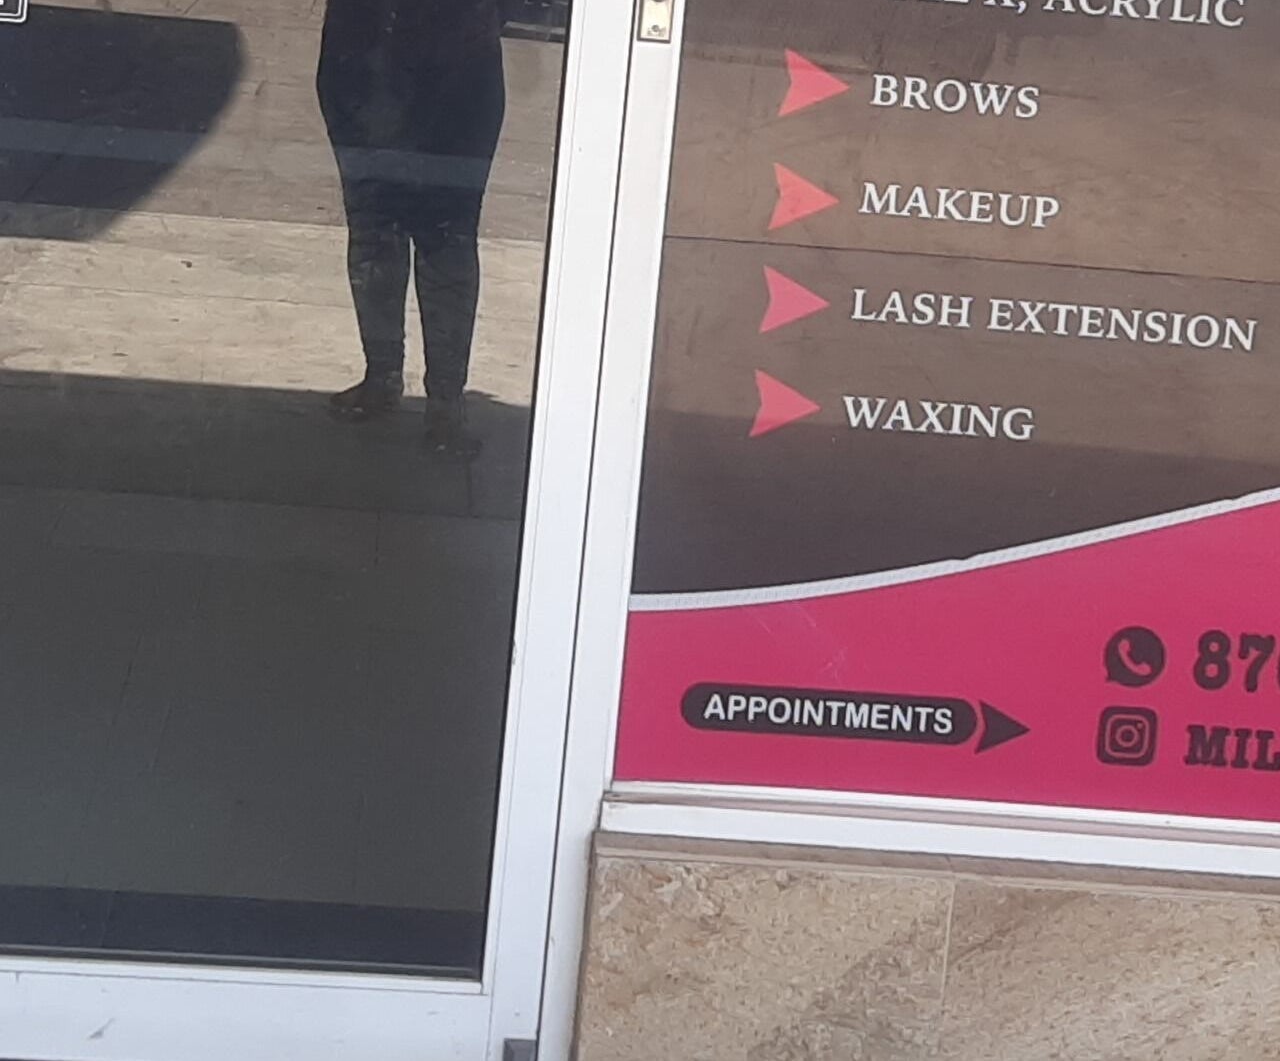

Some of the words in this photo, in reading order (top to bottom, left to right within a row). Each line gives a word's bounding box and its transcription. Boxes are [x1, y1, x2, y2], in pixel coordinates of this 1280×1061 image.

[869, 73, 1041, 119] BROWS
[858, 182, 1061, 229] MAKEUP
[850, 288, 972, 329] LASH
[986, 298, 1258, 353] EXTENSION
[842, 394, 1036, 441] WAXING
[703, 693, 953, 734] APPOINTMENTS
